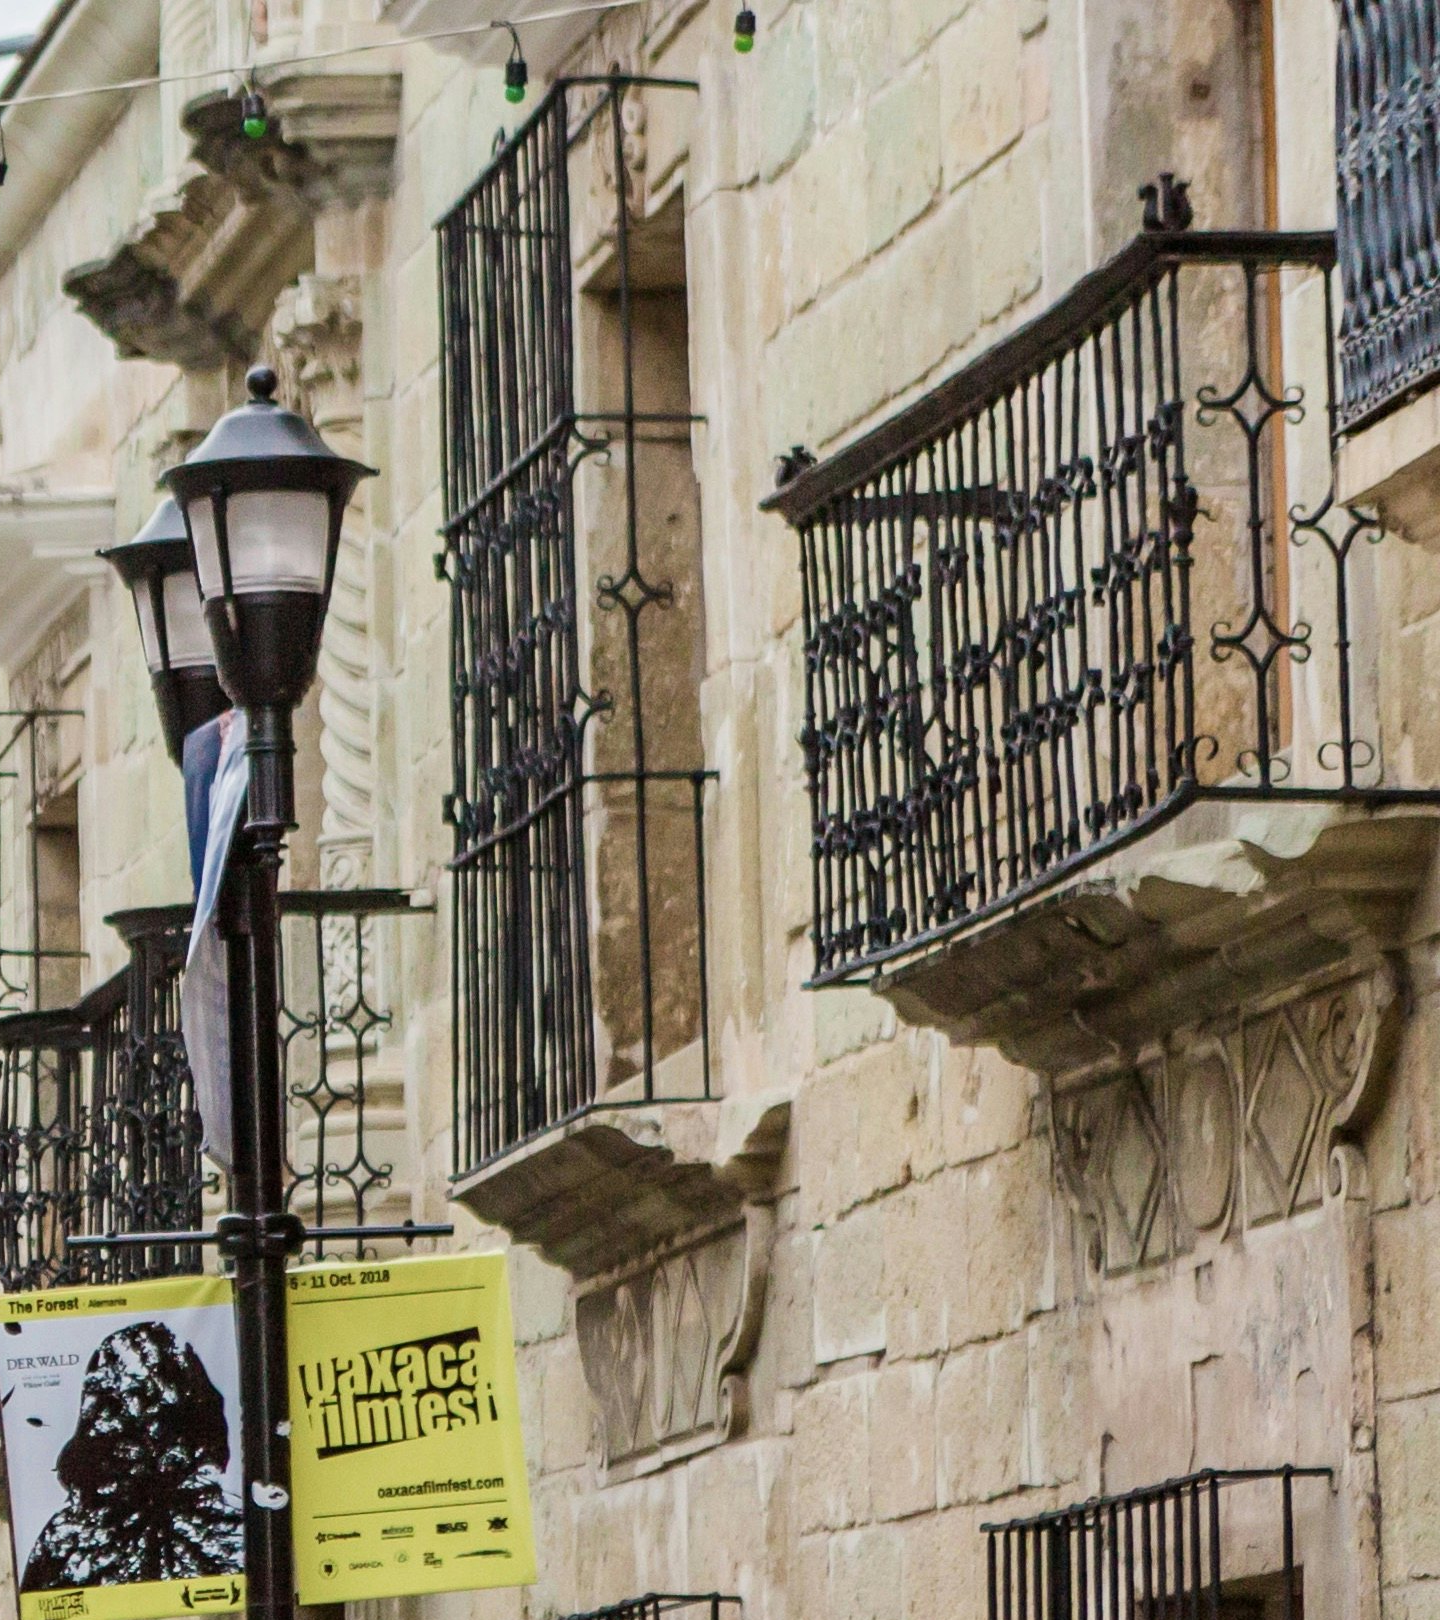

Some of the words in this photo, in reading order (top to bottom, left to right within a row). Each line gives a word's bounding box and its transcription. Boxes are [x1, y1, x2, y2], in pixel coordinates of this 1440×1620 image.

[311, 1276, 326, 1288] 11
[329, 1272, 356, 1287] Oct.
[359, 1269, 391, 1285] 2018
[7, 1301, 33, 1315] The
[36, 1297, 80, 1313] Forest
[376, 1476, 505, 1499] oaxacafilmfest.com
